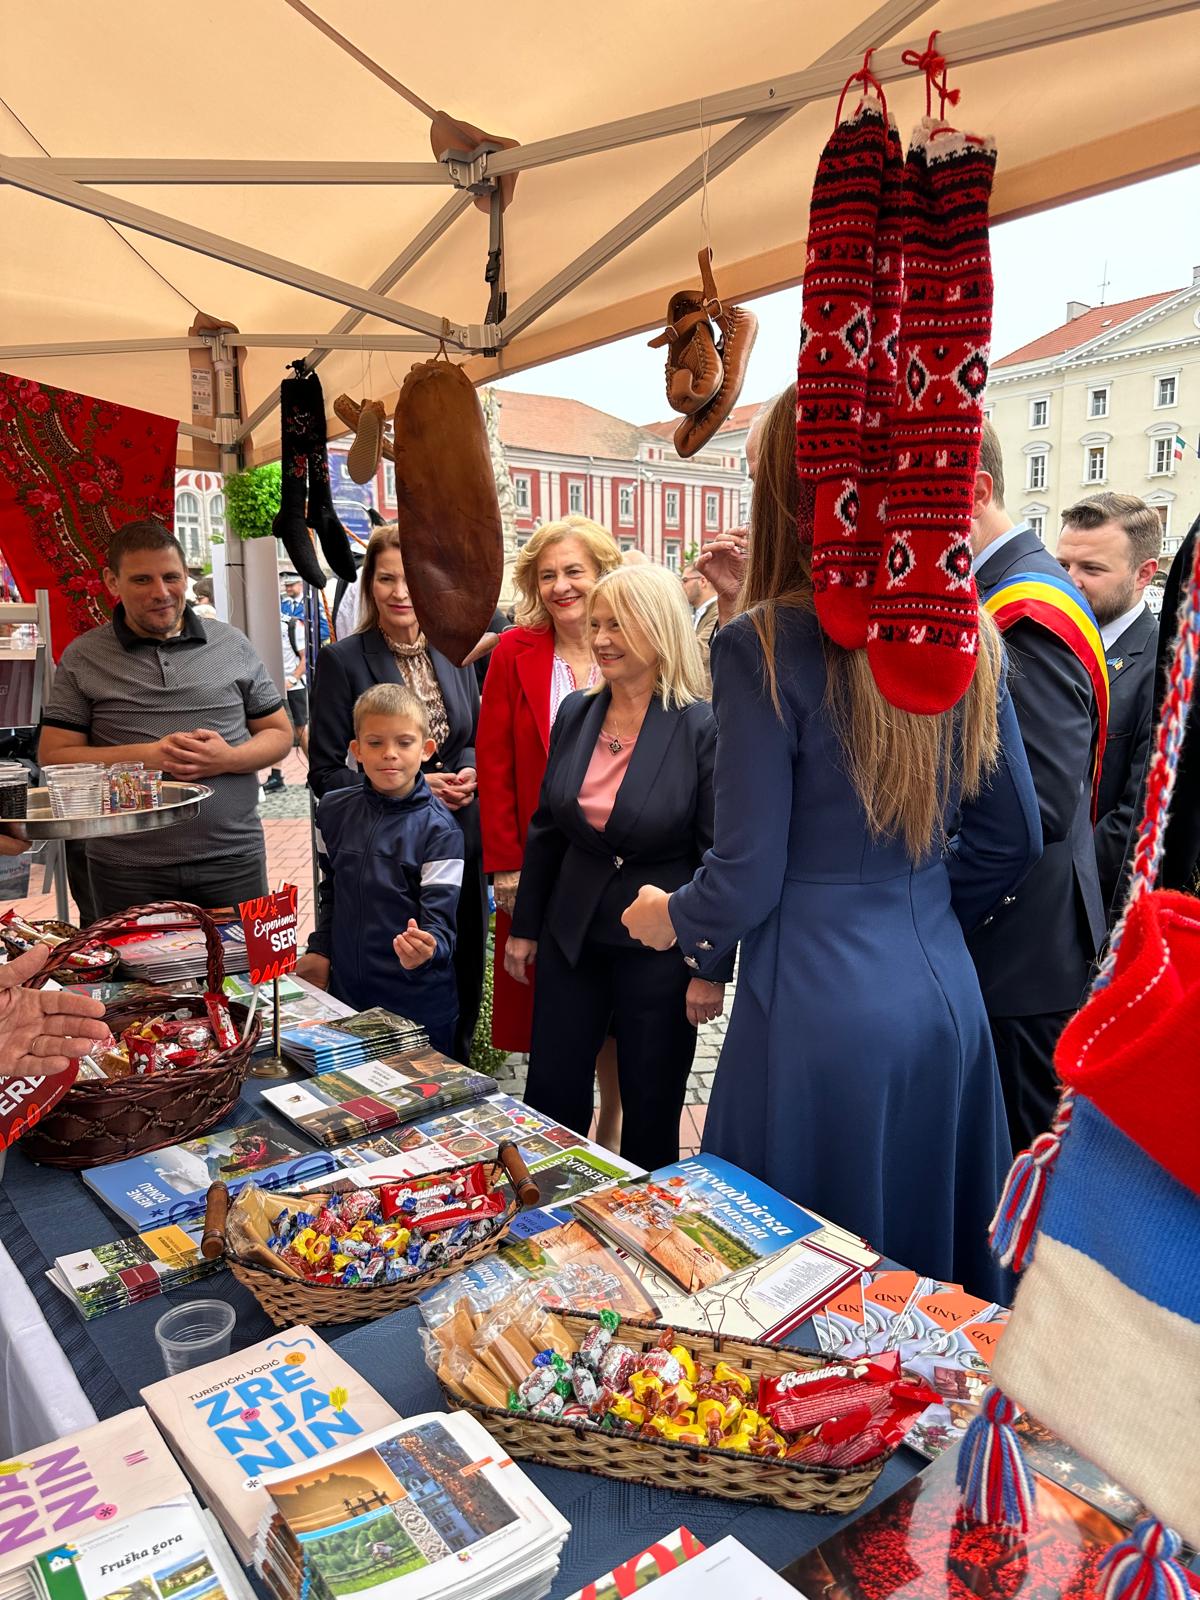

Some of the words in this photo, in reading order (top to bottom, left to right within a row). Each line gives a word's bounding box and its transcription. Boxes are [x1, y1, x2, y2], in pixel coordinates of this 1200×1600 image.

[270, 926, 297, 953] SER
[566, 1156, 611, 1184] SERBIA
[874, 1293, 909, 1305] AND
[926, 1305, 961, 1322] AND
[971, 1329, 997, 1346] ND
[187, 1374, 246, 1401] TURISTIČKI
[246, 1359, 281, 1376] VODIČ
[776, 1365, 848, 1393] Bananica
[194, 1363, 317, 1428] ZRE
[213, 1388, 332, 1456] NJA
[235, 1409, 365, 1478] NIN
[100, 1549, 149, 1576] Fruška
[152, 1533, 184, 1556] gora
